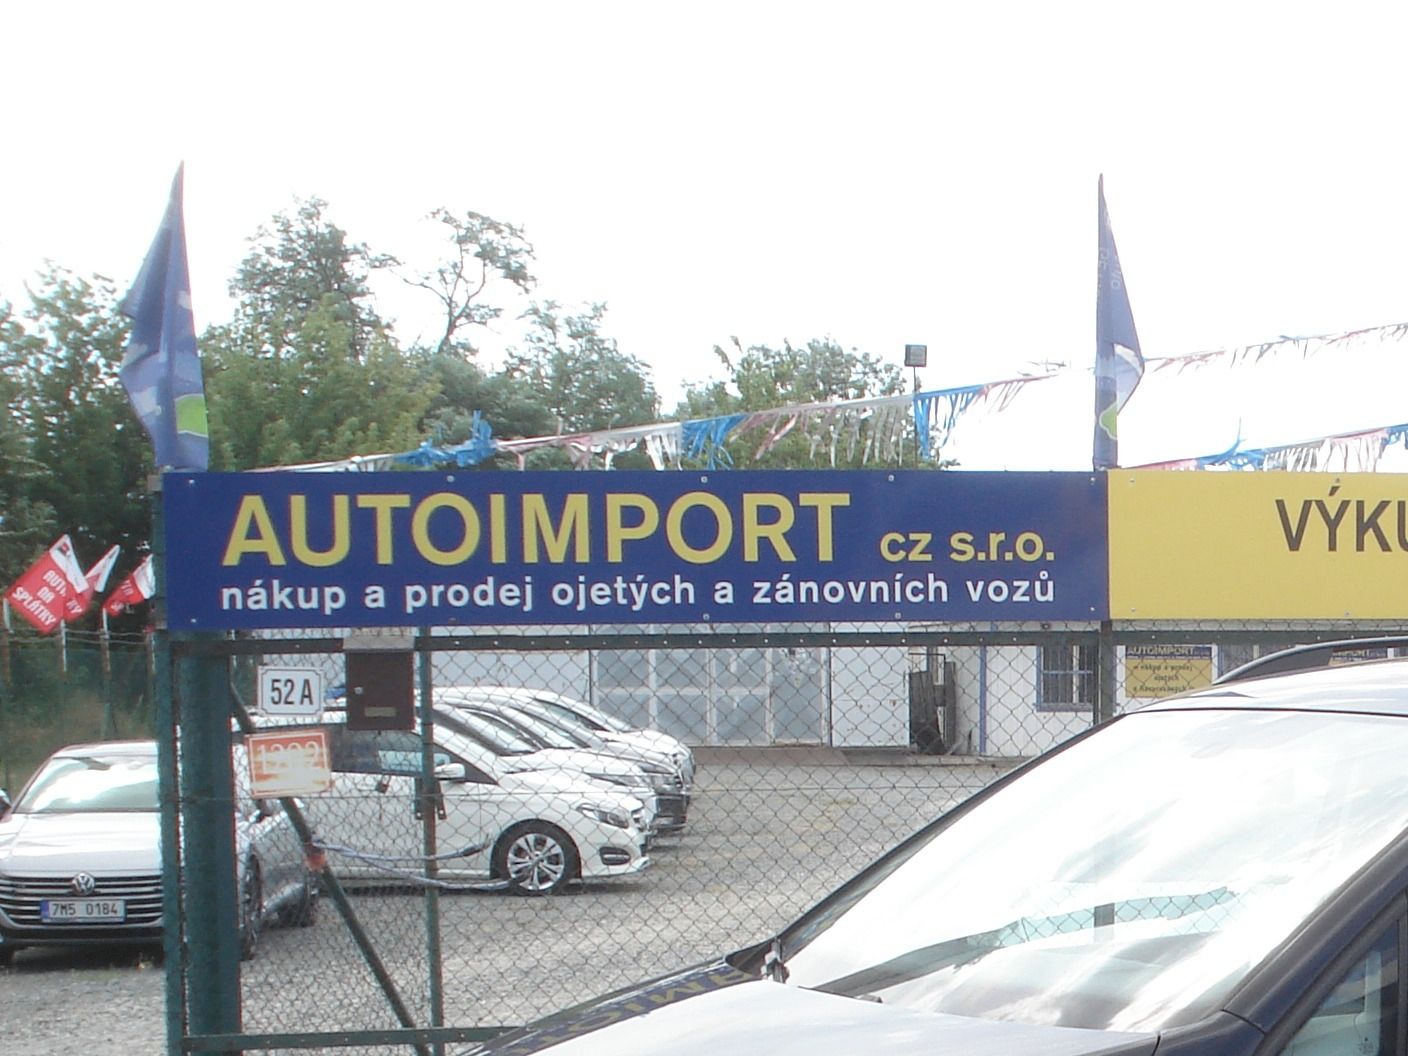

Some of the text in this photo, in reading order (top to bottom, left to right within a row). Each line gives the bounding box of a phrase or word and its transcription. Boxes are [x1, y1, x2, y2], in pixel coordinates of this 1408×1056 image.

[221, 491, 1056, 568] AUTOIMPORT cz s.r.o.
[221, 569, 1056, 615] nákup a prodej ojetých a zánovních vozů
[270, 678, 314, 706] 52 A
[52, 902, 77, 916] 7M5
